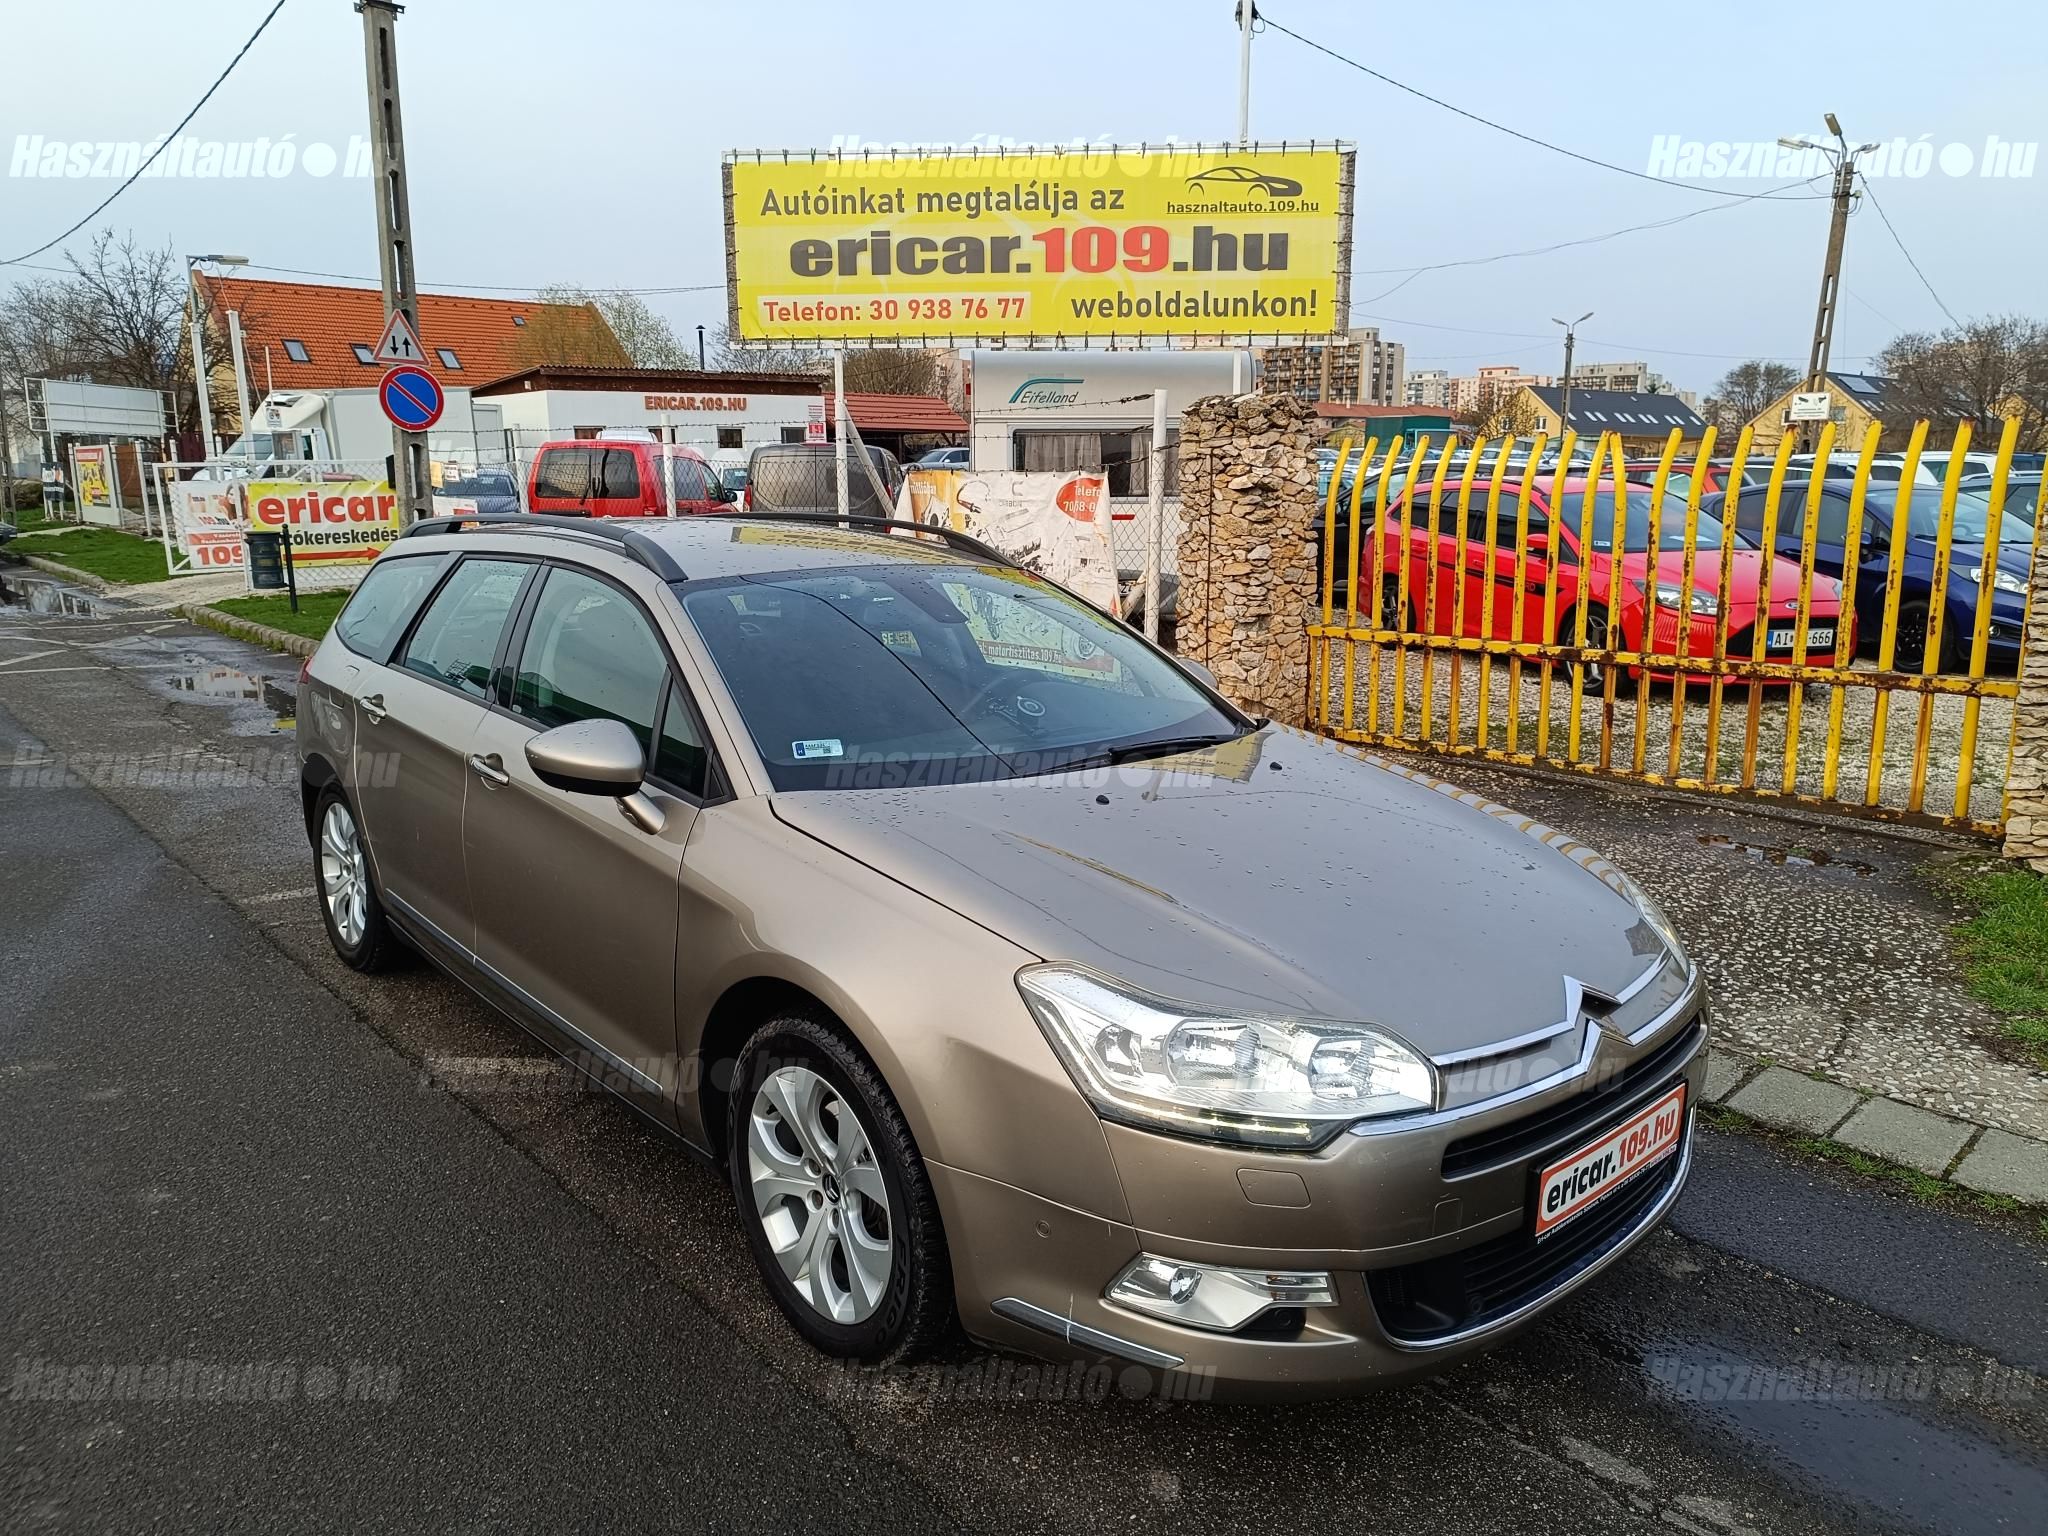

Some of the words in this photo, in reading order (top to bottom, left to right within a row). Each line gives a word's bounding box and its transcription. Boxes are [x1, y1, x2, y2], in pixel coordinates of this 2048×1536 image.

[761, 184, 905, 216] Autóinkat
[917, 179, 1078, 219] megtalálja
[1090, 189, 1124, 210] az
[1167, 200, 1319, 213] hasznaltauto.109.hu
[790, 225, 1289, 277] ericar.109.hu
[763, 301, 861, 322] Telefon:
[870, 299, 898, 320] 30
[908, 299, 952, 320] 938
[962, 298, 988, 319] 76
[998, 297, 1025, 318] 77
[1071, 289, 1317, 318] weboldalunkon!
[644, 396, 747, 411] ERICAR.109.HU
[1021, 391, 1079, 404] Eifelland
[257, 492, 395, 525] ericar
[279, 525, 399, 546] ókereskedés
[1547, 1108, 1676, 1213] ericar.109.hu
